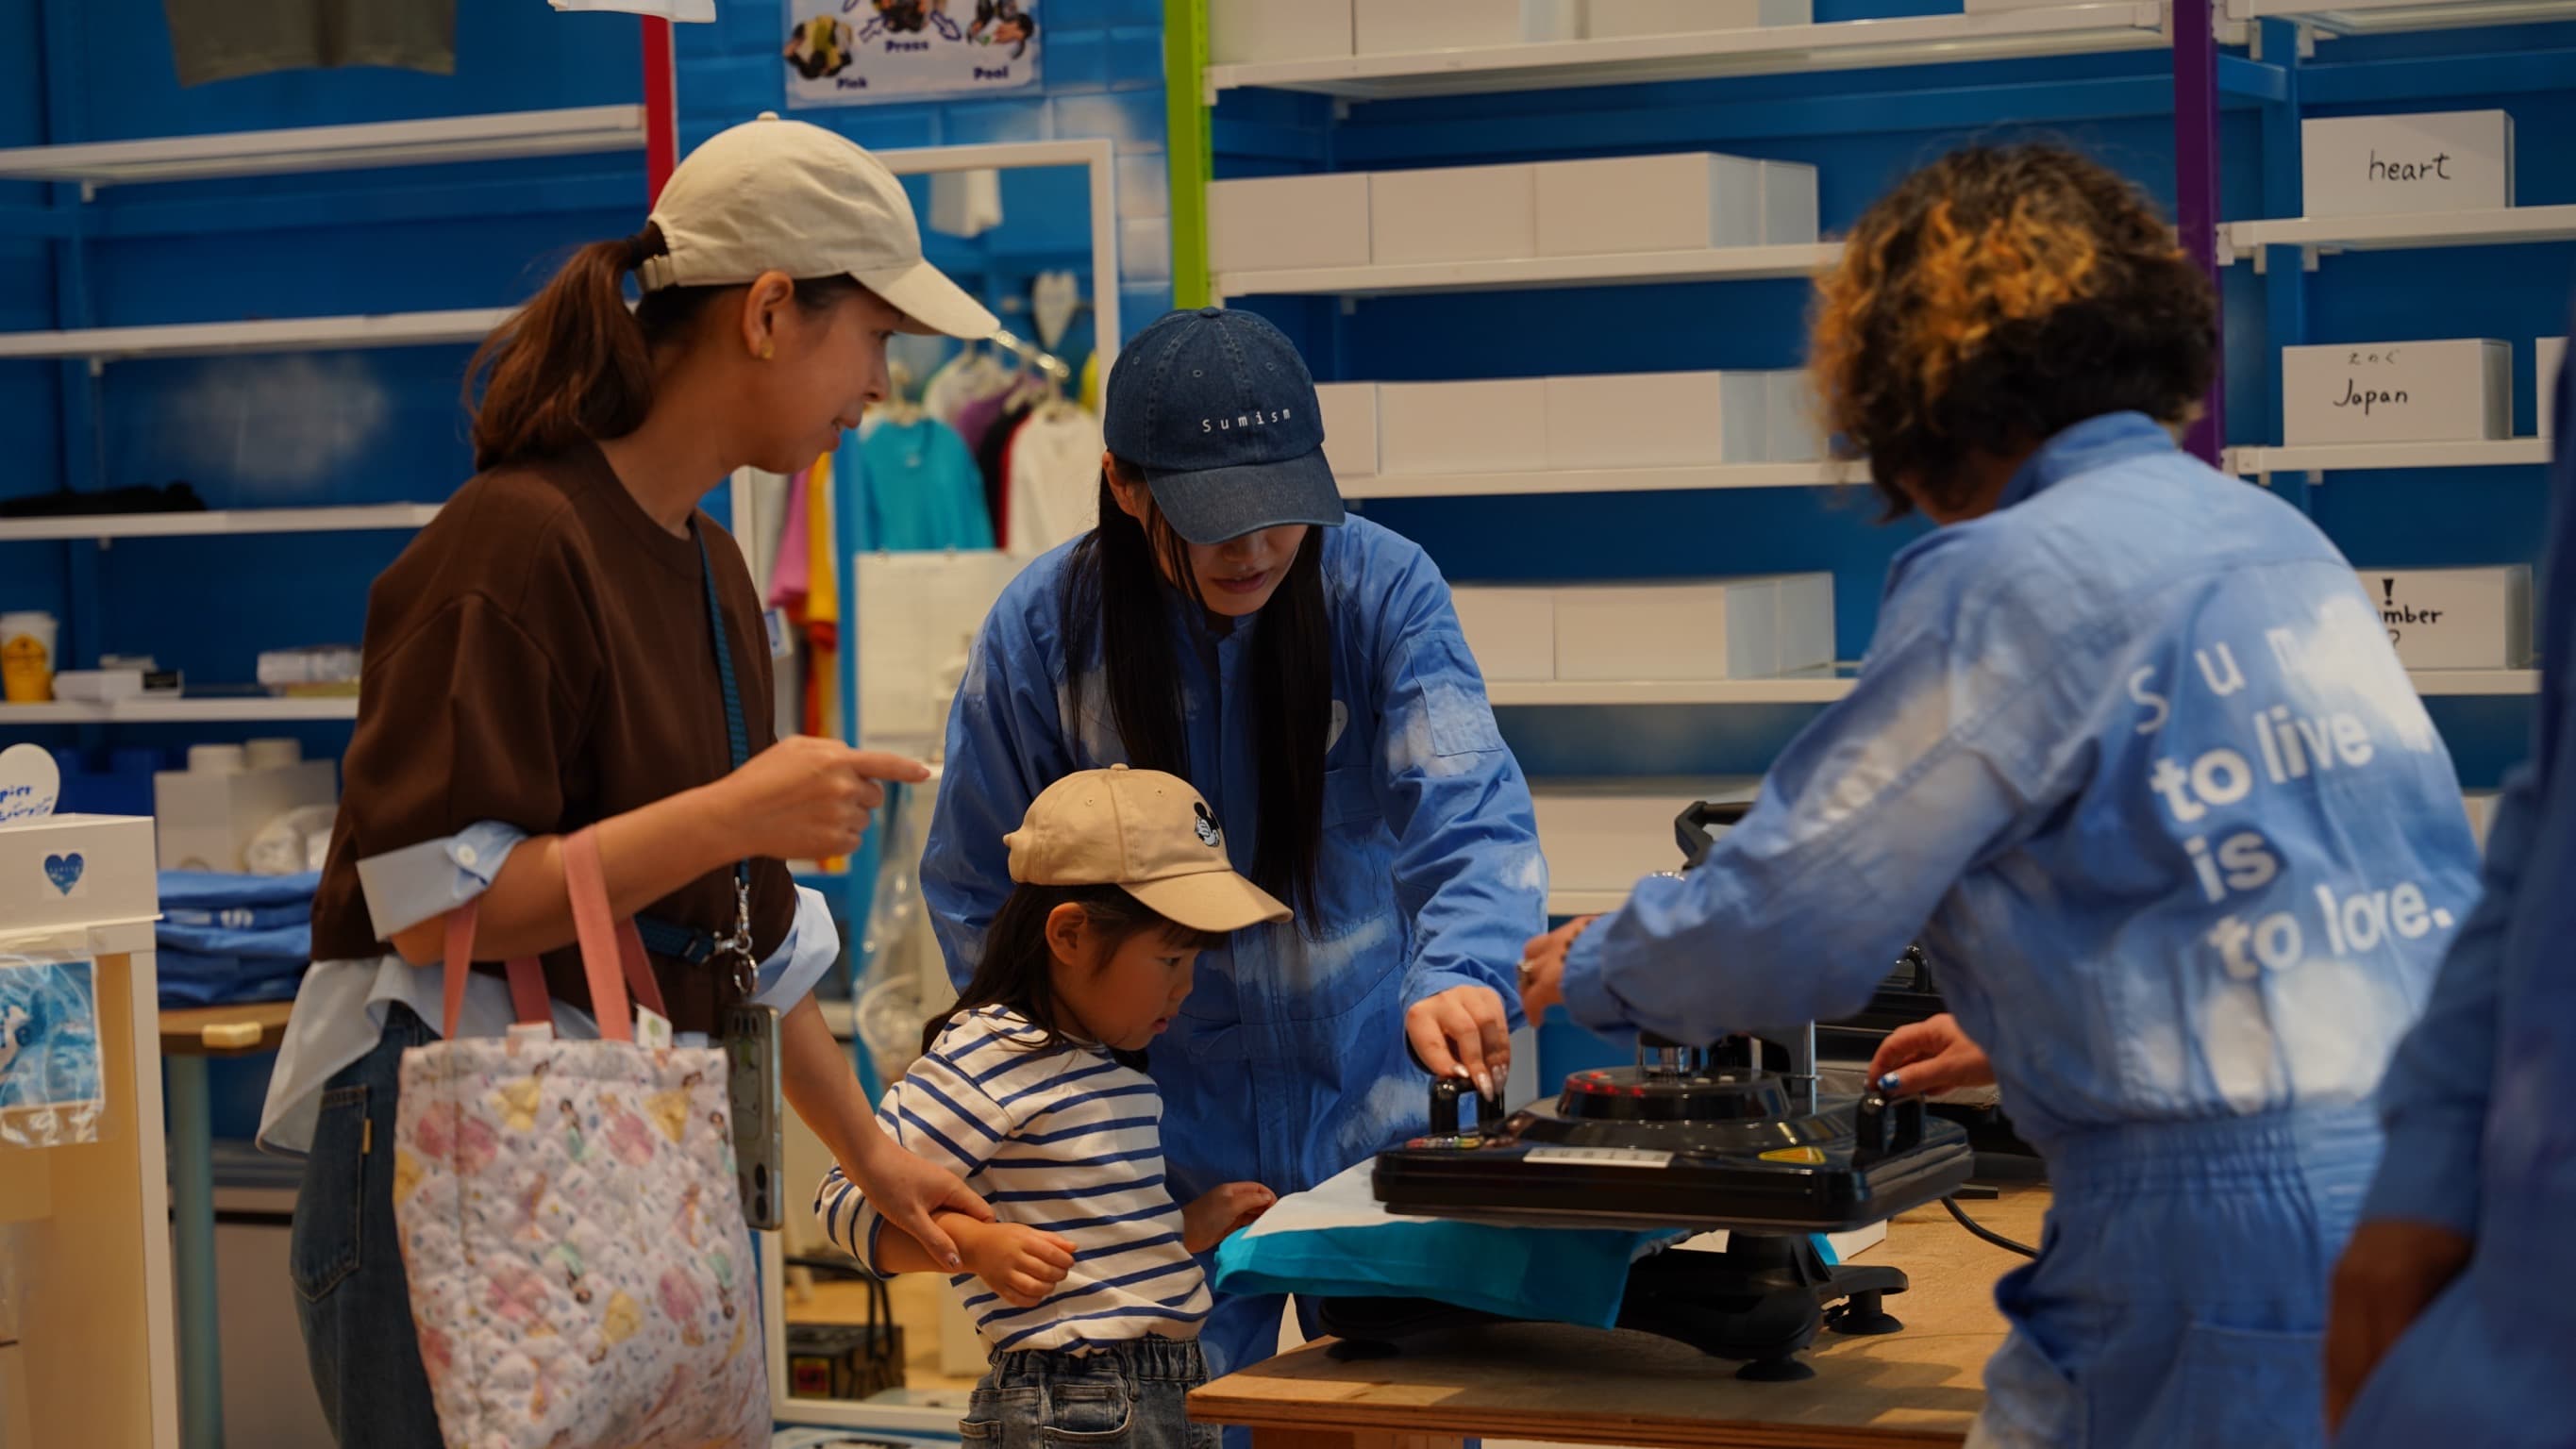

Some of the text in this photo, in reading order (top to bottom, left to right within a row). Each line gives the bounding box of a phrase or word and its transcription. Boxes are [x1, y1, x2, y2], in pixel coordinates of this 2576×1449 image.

[2367, 148, 2451, 182] heart
[1202, 408, 1291, 433] Sumism
[2333, 377, 2409, 416] Japan
[2149, 704, 2375, 822] to live
[2184, 832, 2277, 904] is
[2208, 910, 2302, 980] to
